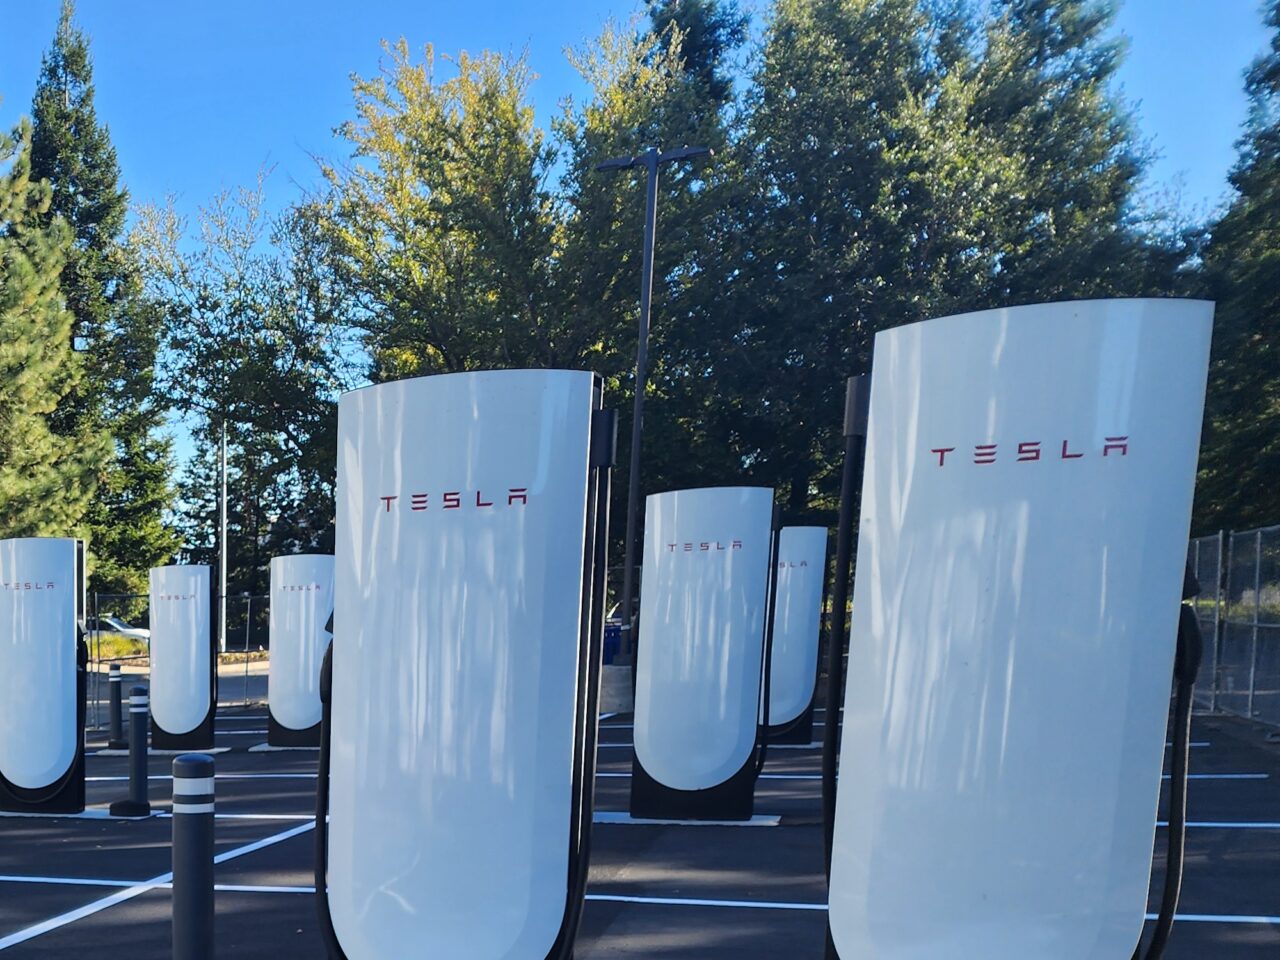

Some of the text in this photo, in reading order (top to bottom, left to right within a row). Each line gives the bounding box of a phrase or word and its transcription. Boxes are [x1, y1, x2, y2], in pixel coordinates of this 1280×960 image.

[930, 436, 1129, 467] TESLA
[380, 488, 528, 512] TESLA
[668, 540, 743, 552] TESLA
[4, 582, 55, 590] TESLA
